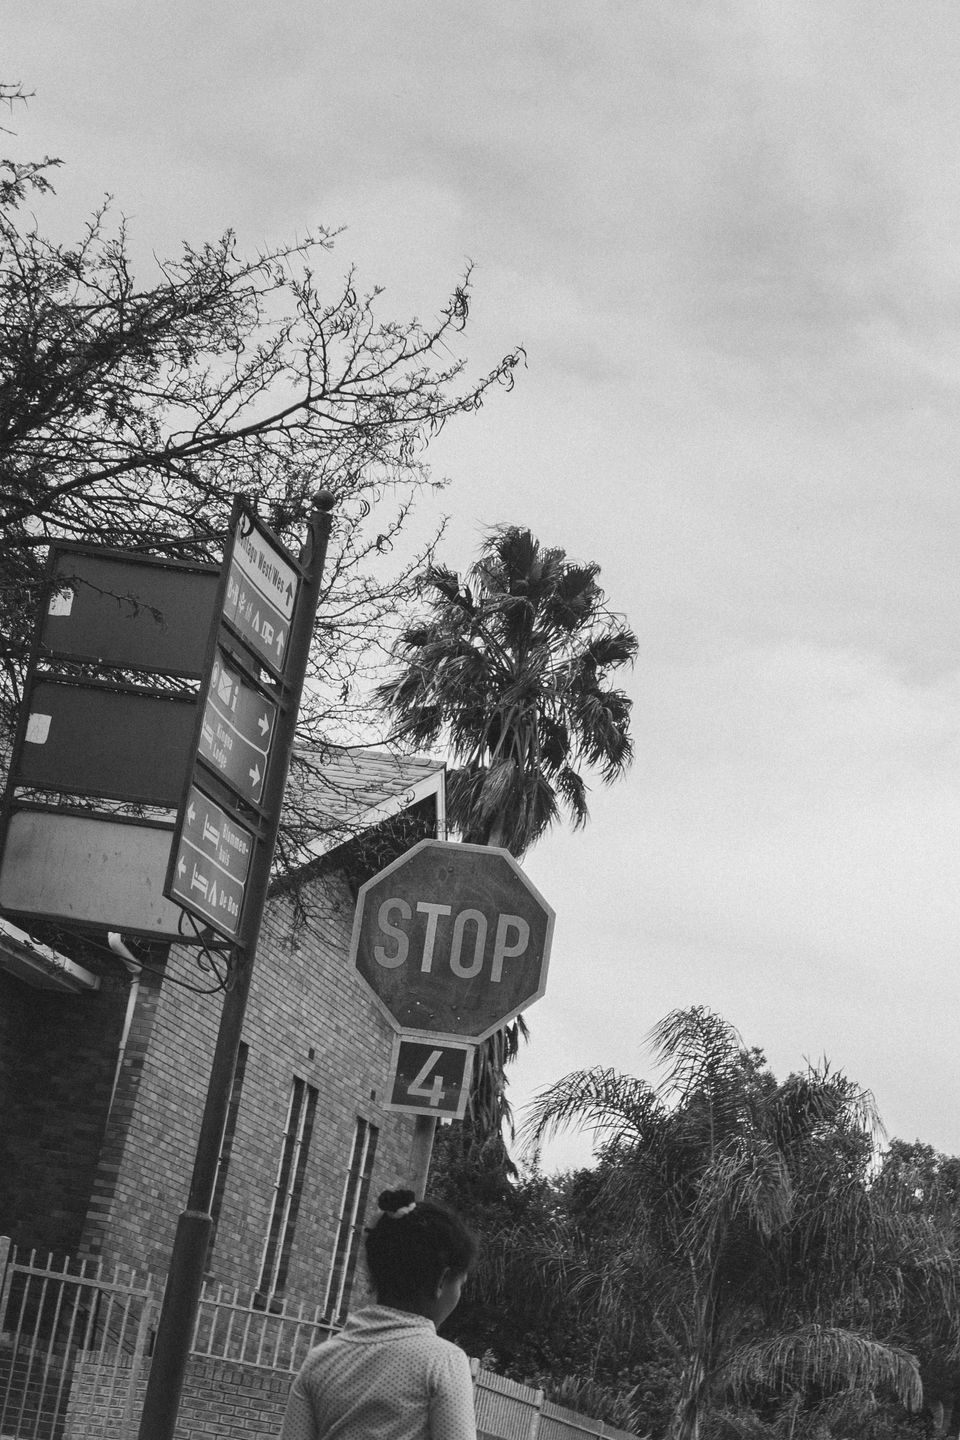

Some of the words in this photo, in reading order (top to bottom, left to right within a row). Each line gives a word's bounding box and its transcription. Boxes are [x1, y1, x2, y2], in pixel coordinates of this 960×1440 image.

[258, 551, 285, 594] West/Wes
[373, 897, 530, 983] STOP
[407, 1050, 446, 1107] 4
